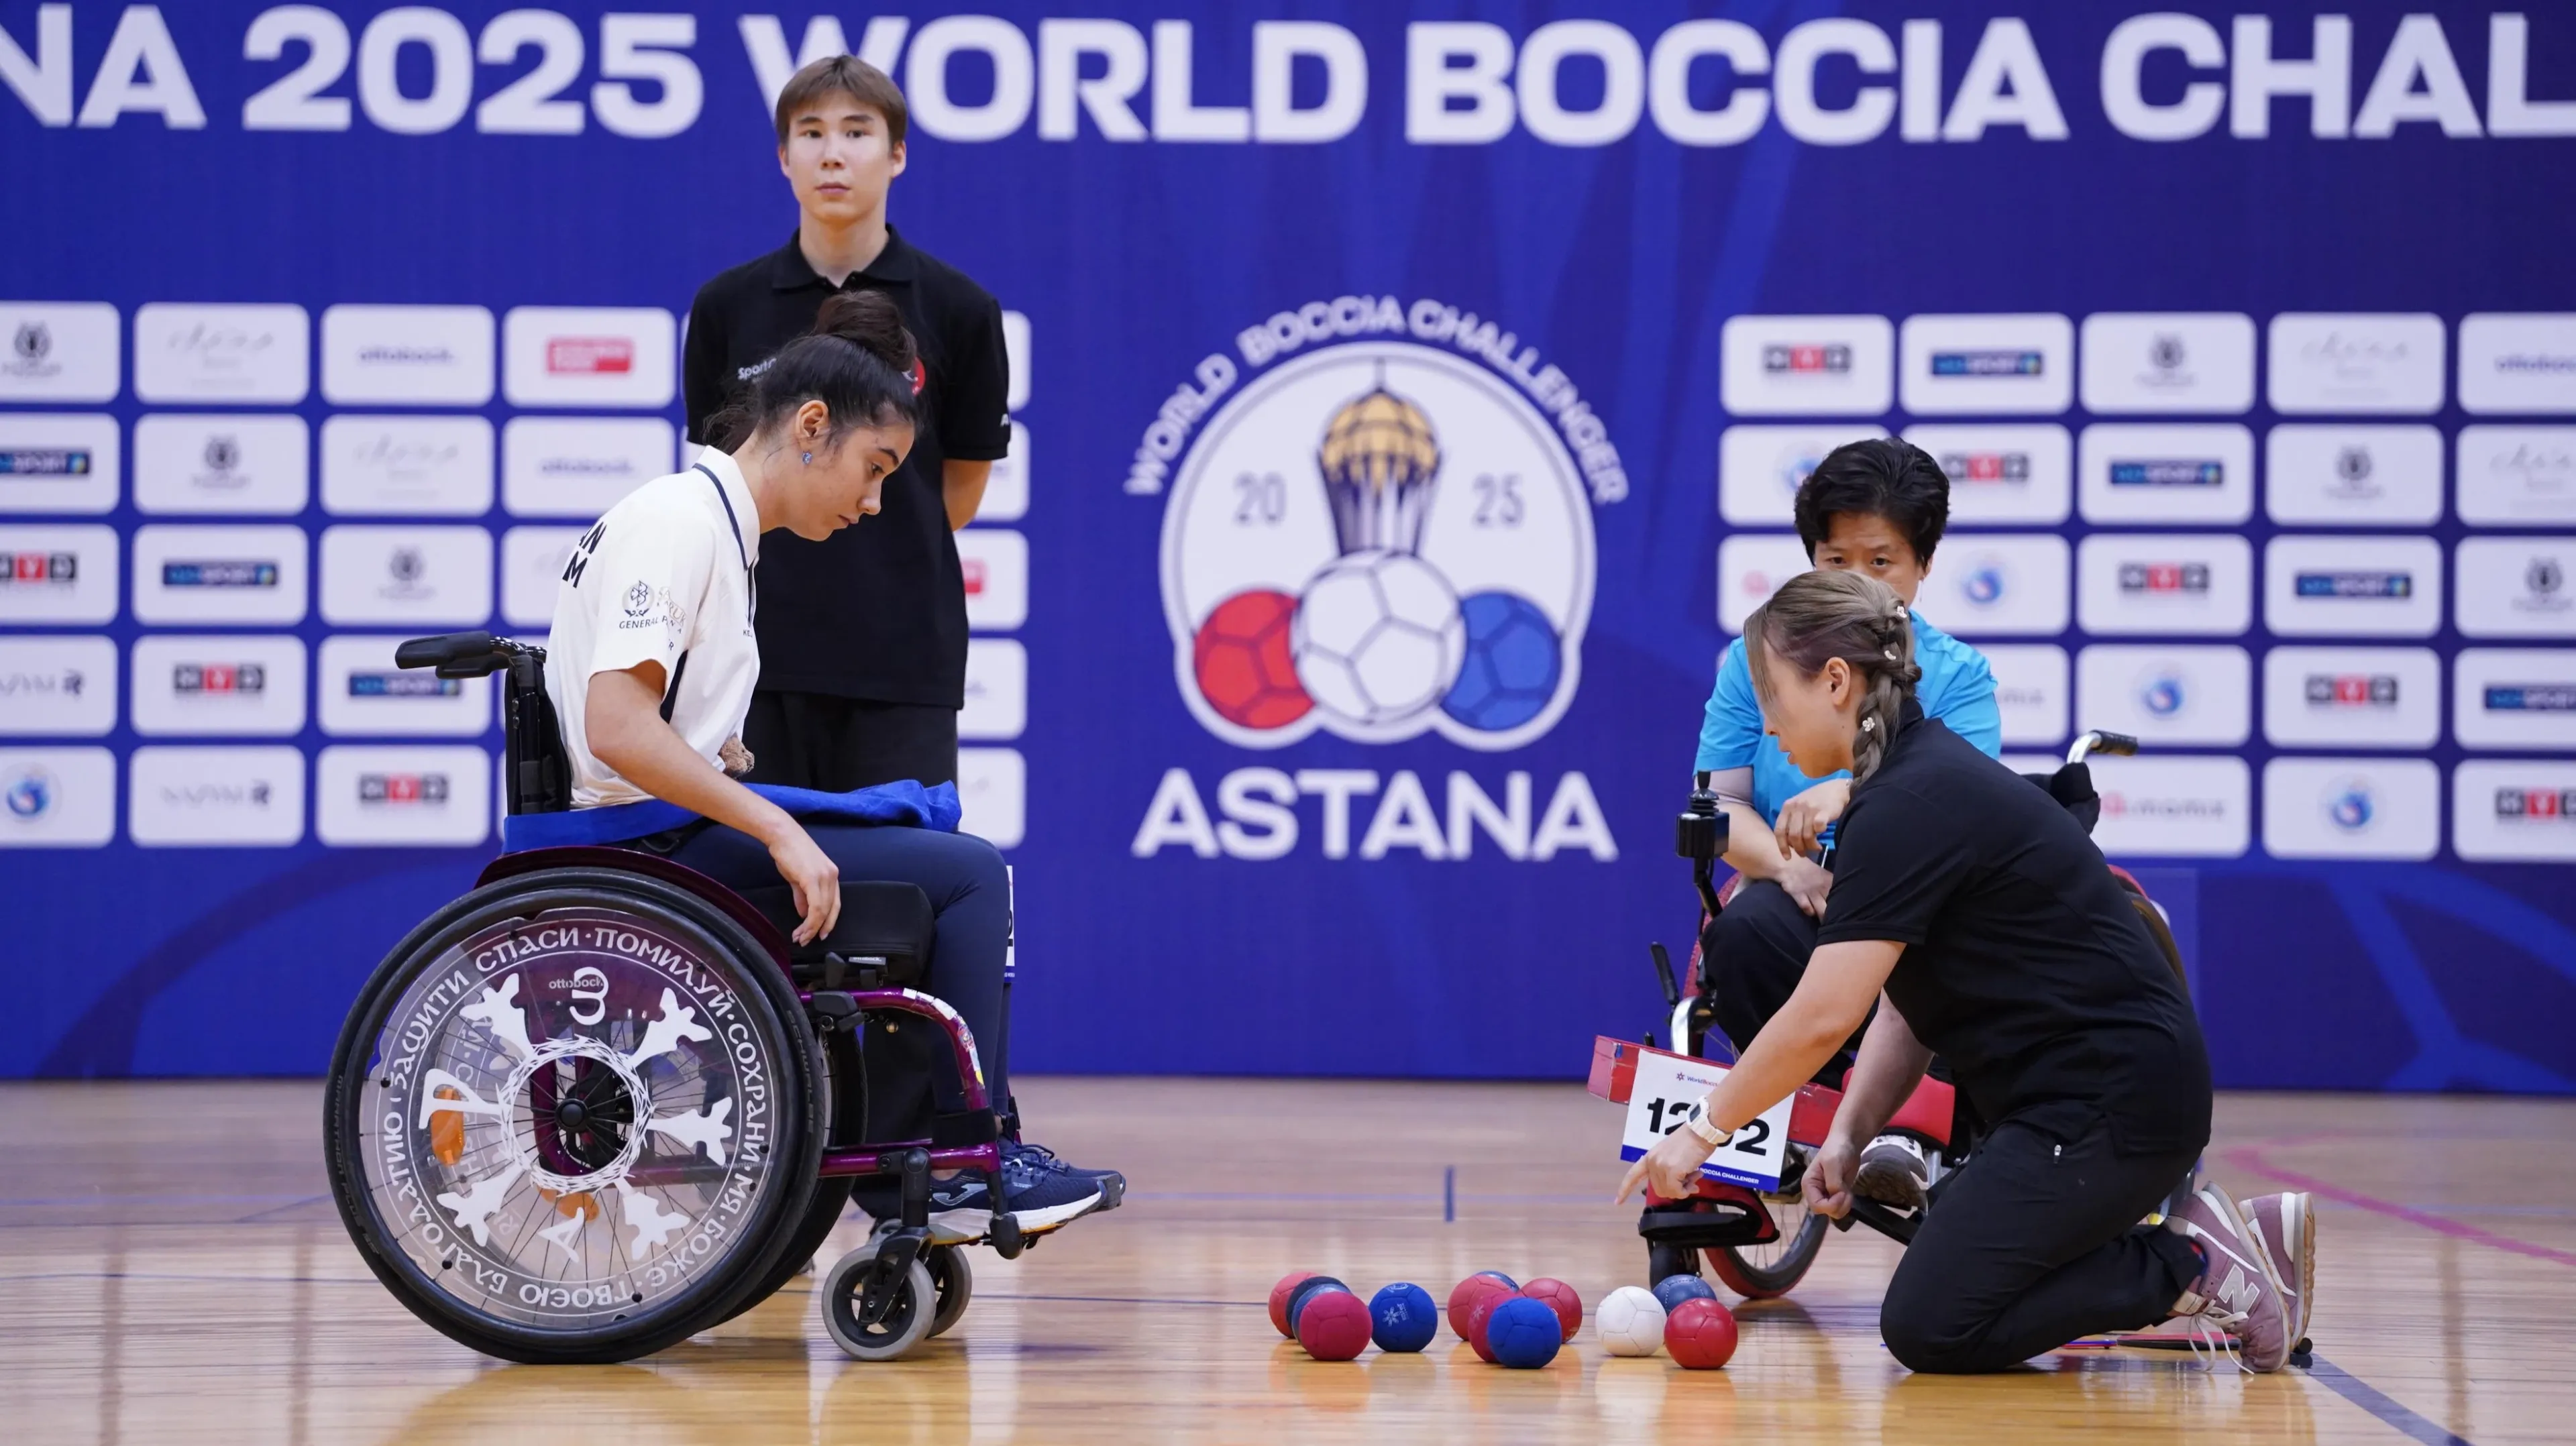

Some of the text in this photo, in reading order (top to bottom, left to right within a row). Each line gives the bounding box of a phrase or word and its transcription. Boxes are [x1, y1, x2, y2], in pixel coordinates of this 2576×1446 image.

[0, 3, 2576, 147] NA 2025 WORLD BOCCIA CHAL
[1123, 295, 1629, 506] WORLD BOCCIA CHALLENGER
[1232, 472, 1526, 527] 20 25
[619, 616, 659, 630] GENERAL
[1131, 766, 1619, 863] ASTANA
[1647, 1097, 1770, 1156] 122
[1721, 1172, 1759, 1184] CHALLENGER
